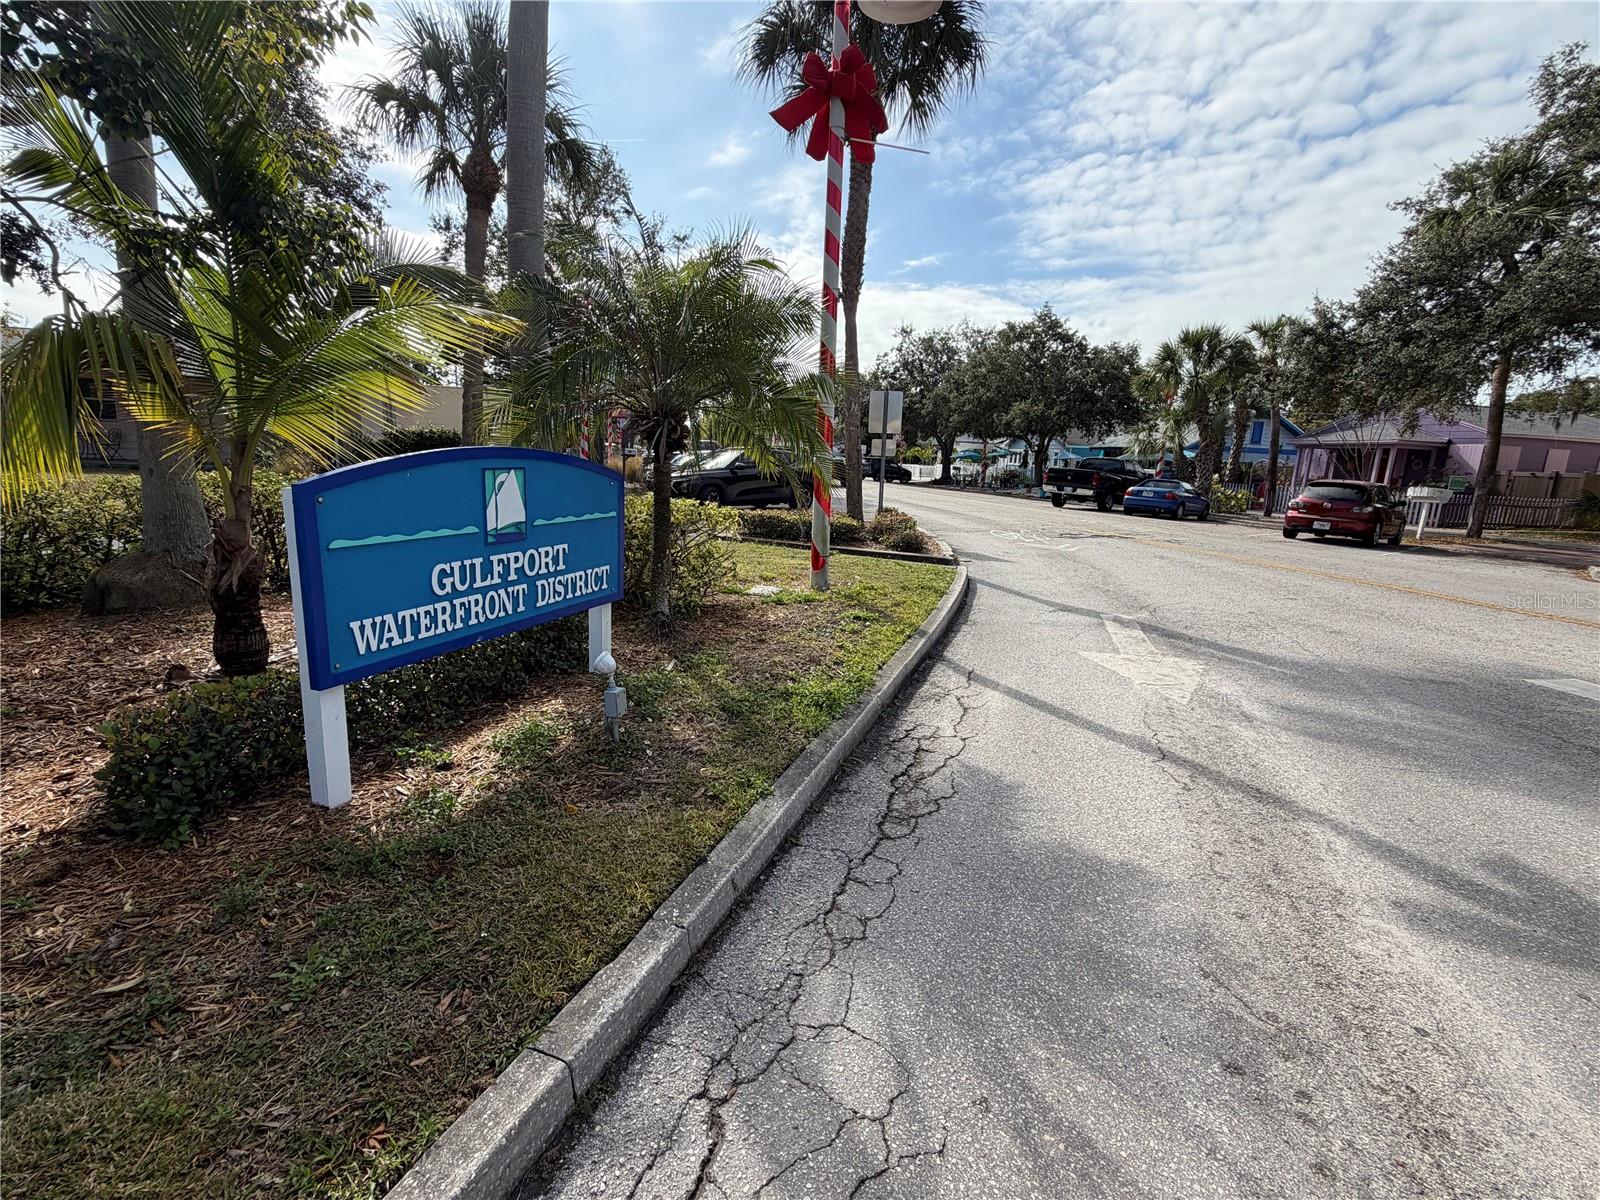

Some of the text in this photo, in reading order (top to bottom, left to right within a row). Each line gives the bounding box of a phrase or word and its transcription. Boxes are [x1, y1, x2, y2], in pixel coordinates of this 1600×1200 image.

[431, 543, 568, 596] GULFPORT
[349, 565, 610, 655] WATERFRONT DISTRICT
